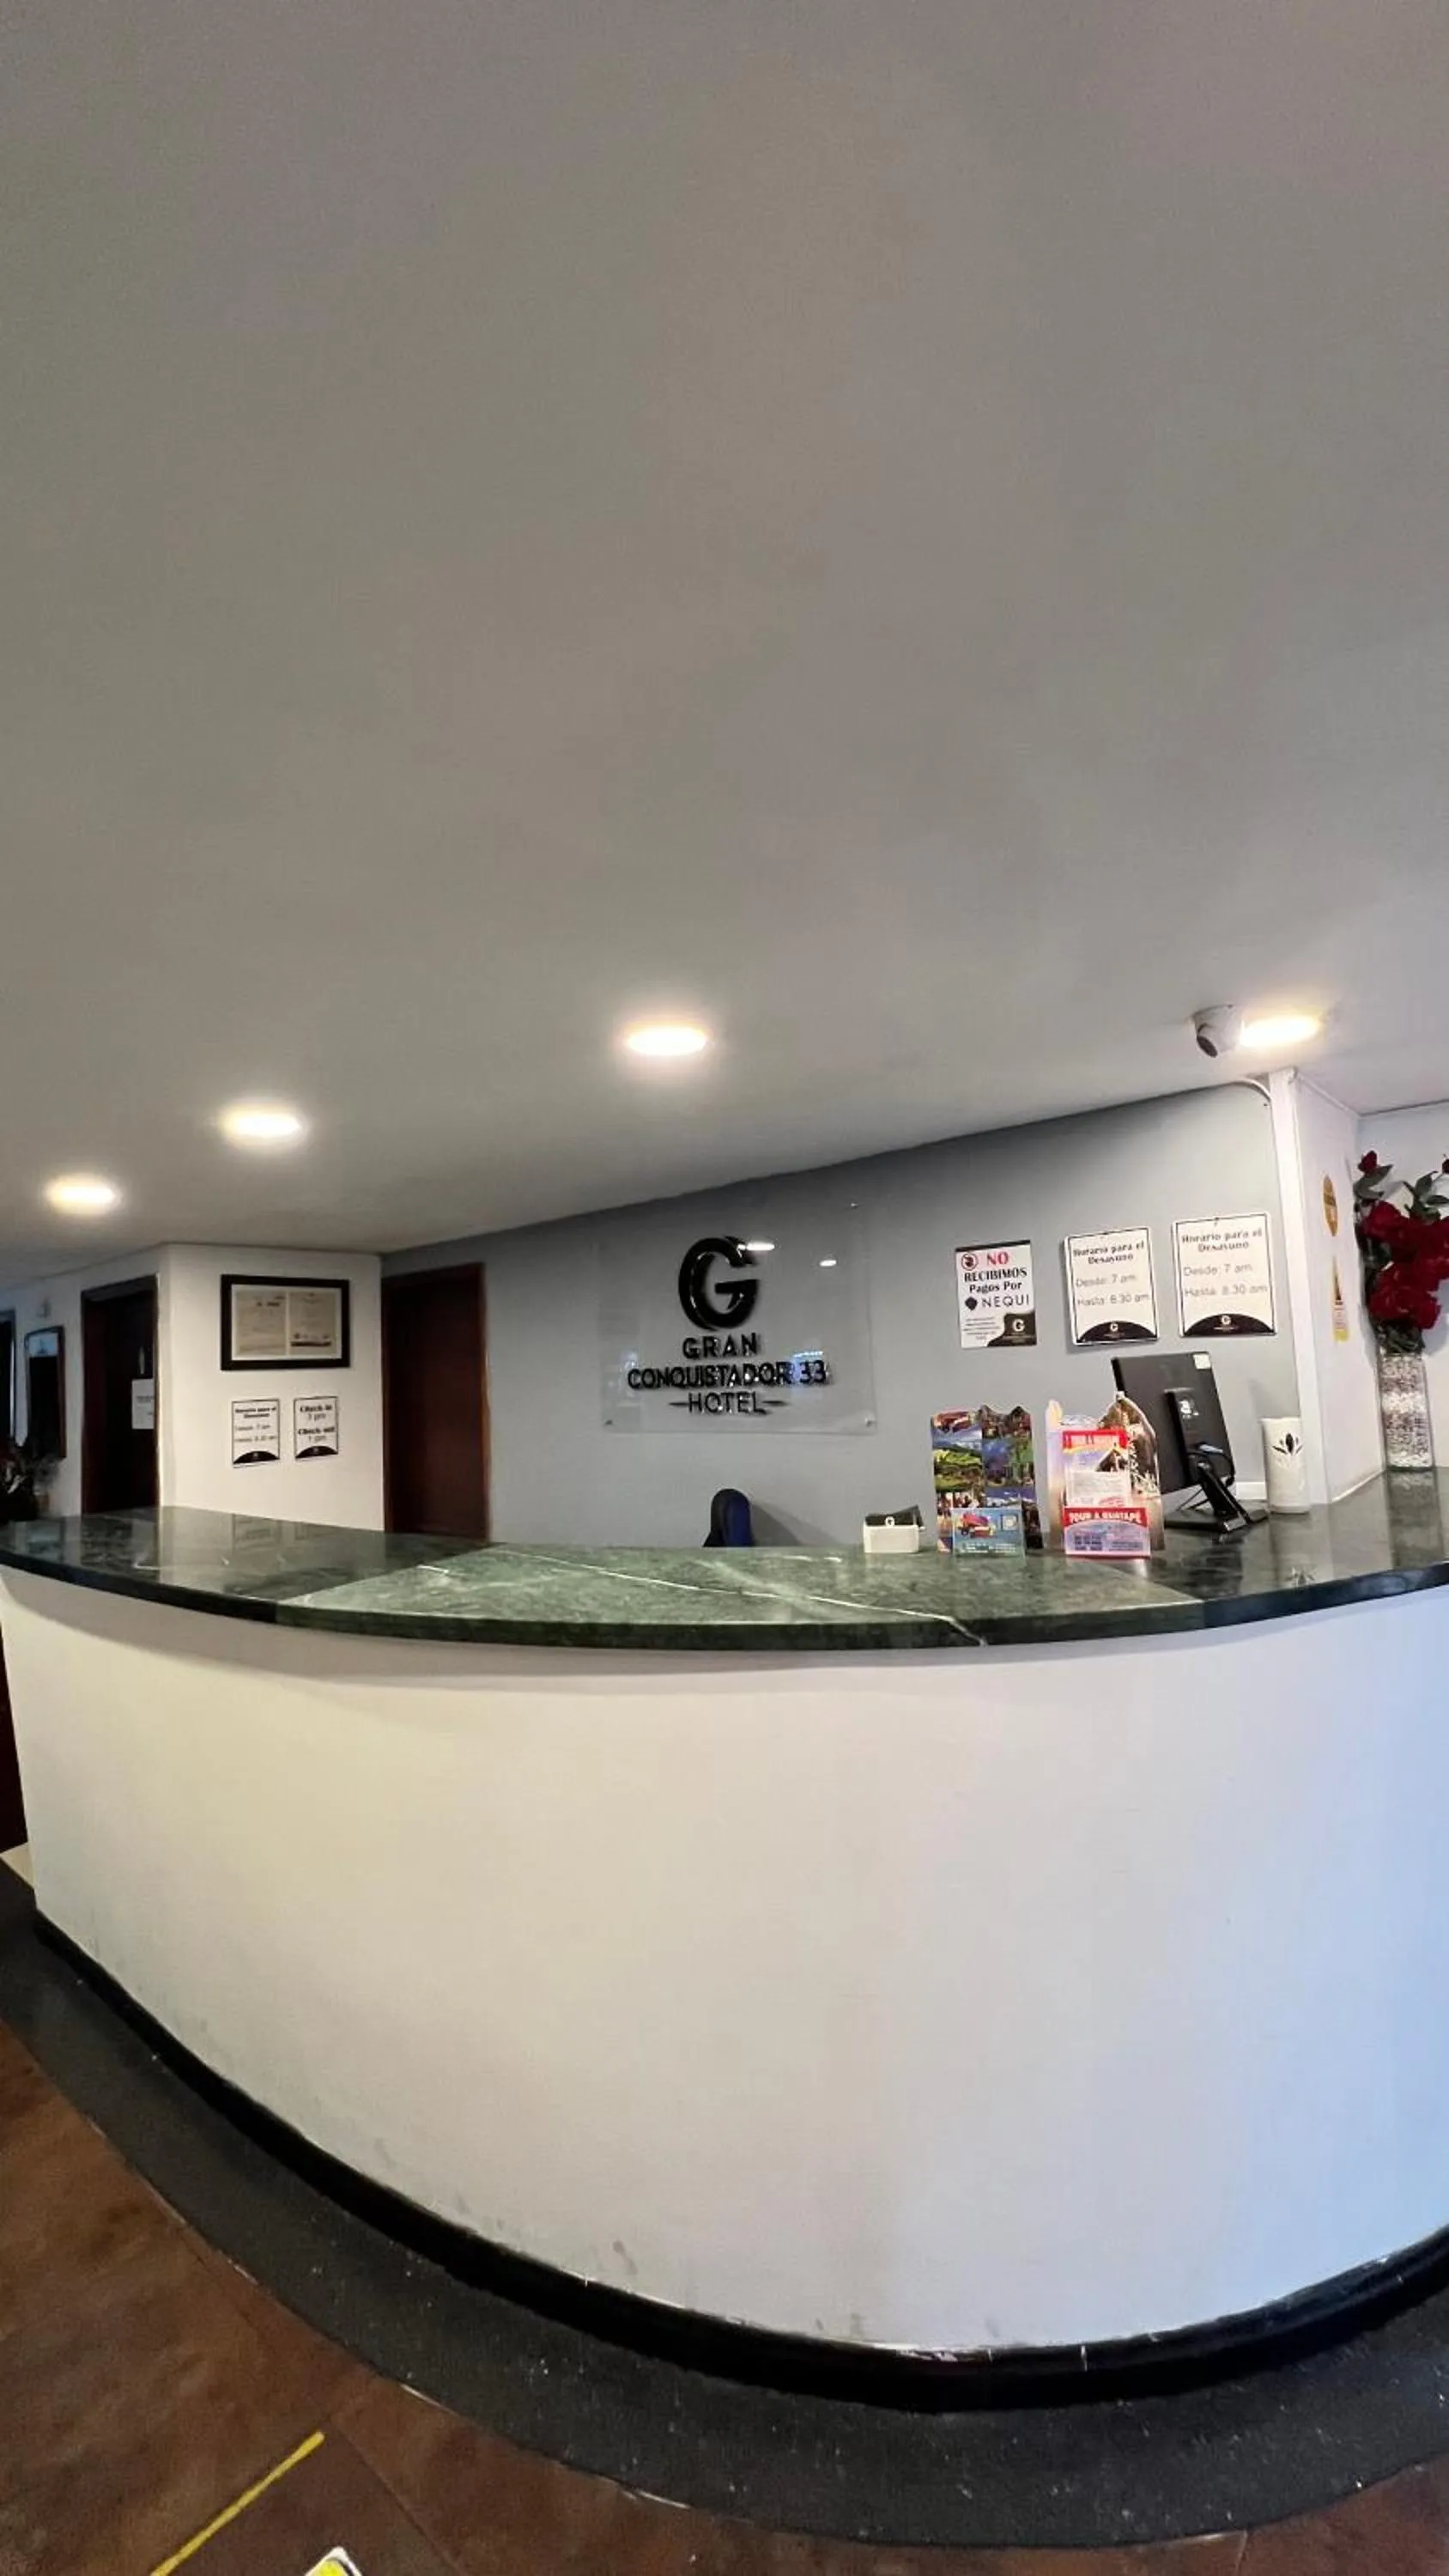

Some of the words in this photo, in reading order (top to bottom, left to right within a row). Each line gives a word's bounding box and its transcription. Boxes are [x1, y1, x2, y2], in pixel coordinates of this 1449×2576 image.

[987, 1250, 1009, 1266] NO
[678, 1236, 759, 1331] G
[964, 1267, 1028, 1283] RECIBIMOS
[969, 1283, 1000, 1295] Pagos
[1003, 1279, 1022, 1291] Por
[981, 1293, 1029, 1309] NEQUI
[682, 1334, 759, 1360] GRAN
[627, 1362, 791, 1389] CONQUISTADOR
[797, 1360, 828, 1385] 33
[688, 1392, 765, 1415] HOTEL
